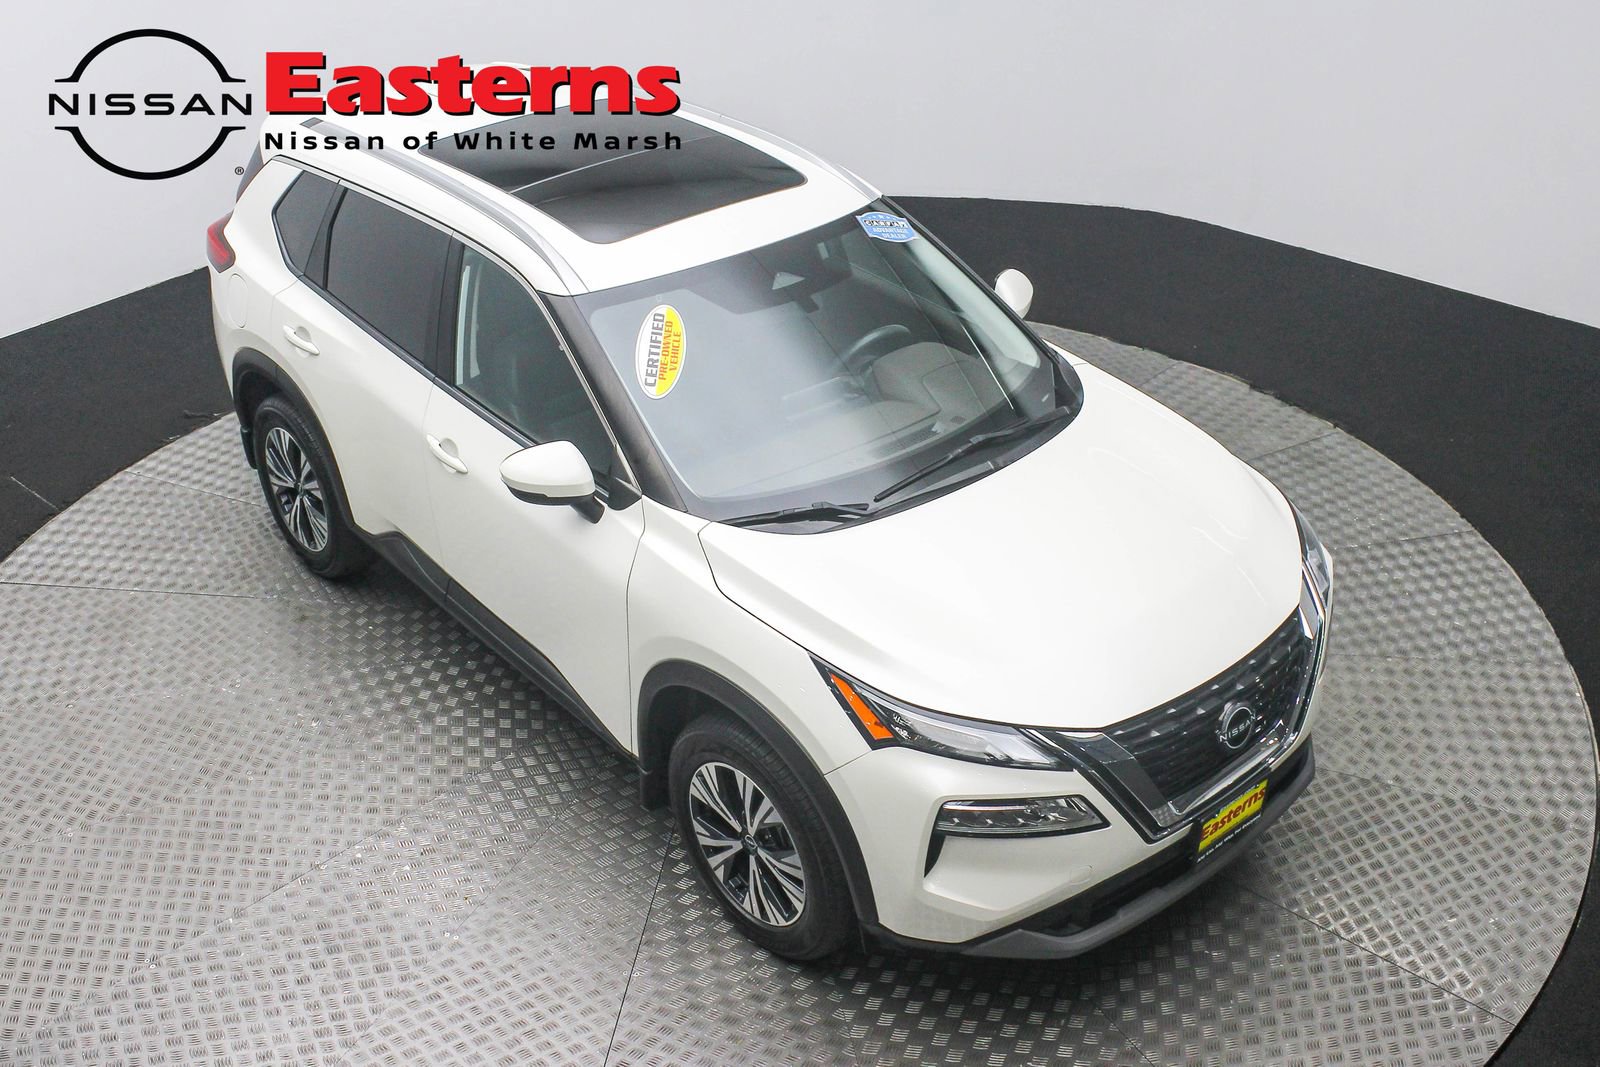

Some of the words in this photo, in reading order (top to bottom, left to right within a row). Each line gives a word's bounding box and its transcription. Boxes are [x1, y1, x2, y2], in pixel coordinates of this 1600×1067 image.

[644, 312, 665, 387] CERTIFIED
[658, 320, 674, 381] PRE-OWNED
[668, 331, 682, 371] VEHICLE
[1218, 712, 1257, 743] NISSAN
[1199, 788, 1266, 842] Easterns
